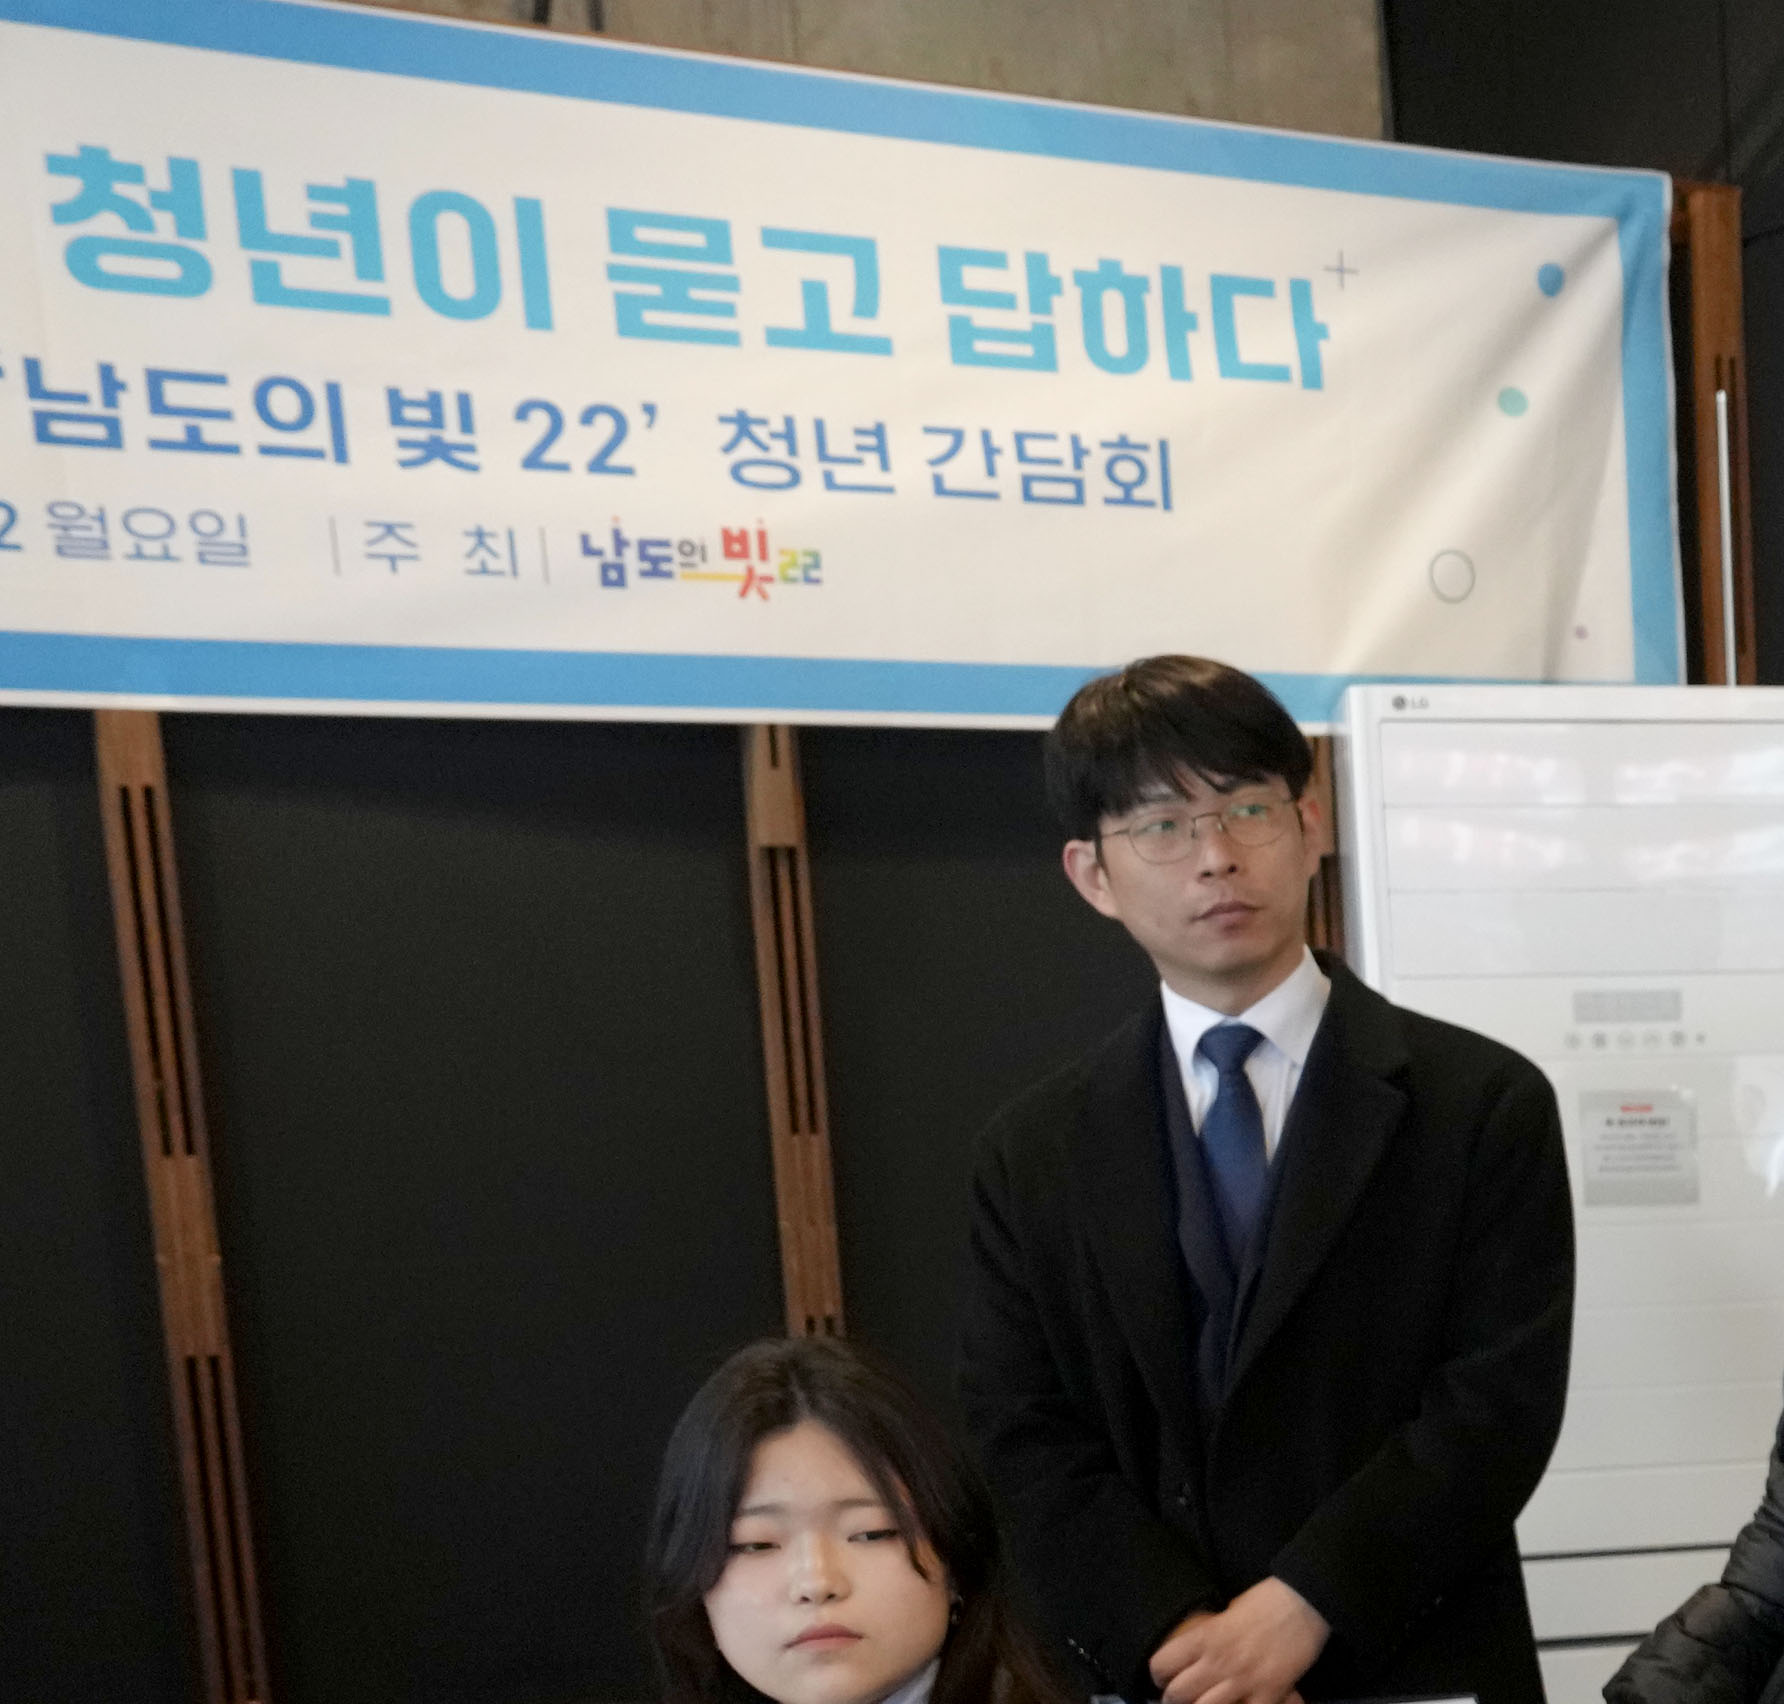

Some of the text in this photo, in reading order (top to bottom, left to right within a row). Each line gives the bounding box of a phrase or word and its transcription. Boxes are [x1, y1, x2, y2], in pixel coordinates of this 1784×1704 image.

[43, 143, 1329, 391] 청년이 묻고 답하다
[385, 386, 481, 473] 빛
[716, 408, 896, 495] 청년
[922, 425, 1174, 512] 간담회
[45, 499, 251, 568] 월요일
